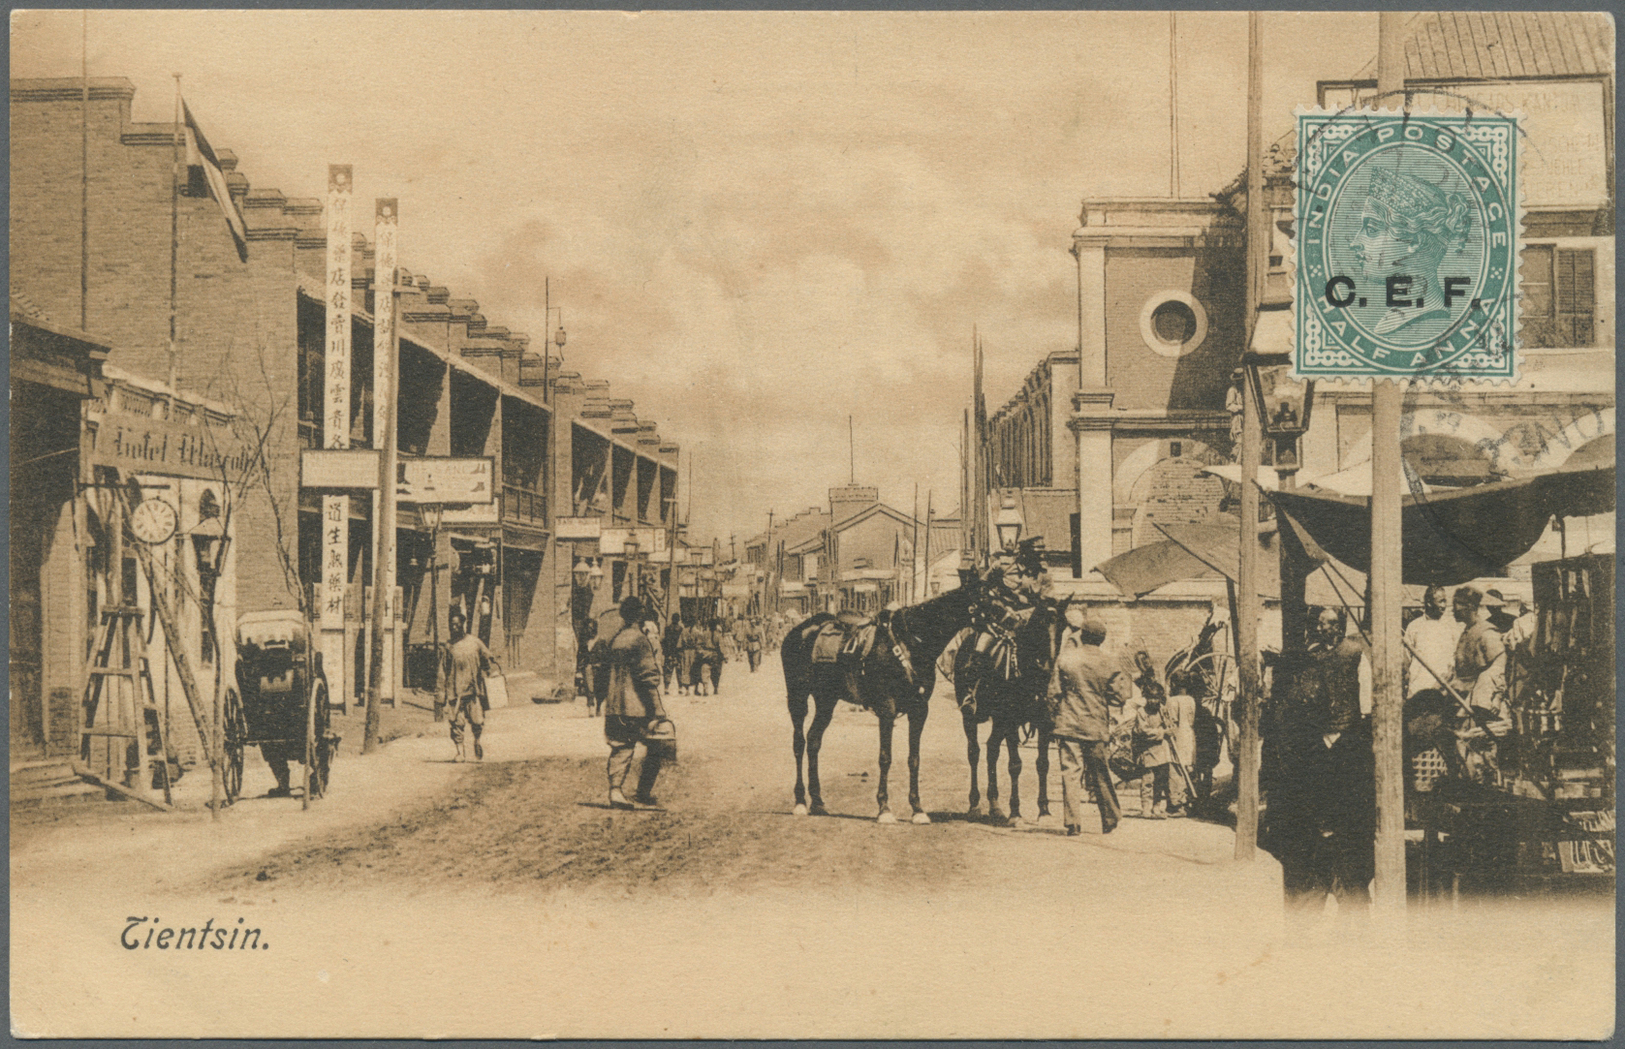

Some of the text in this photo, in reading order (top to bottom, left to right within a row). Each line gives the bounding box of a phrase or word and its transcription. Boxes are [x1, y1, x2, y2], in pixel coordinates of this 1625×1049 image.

[1307, 124, 1506, 249] INDIA POSTAGE
[1324, 275, 1482, 309] C. E. F.
[1317, 296, 1496, 367] HALF ANNA
